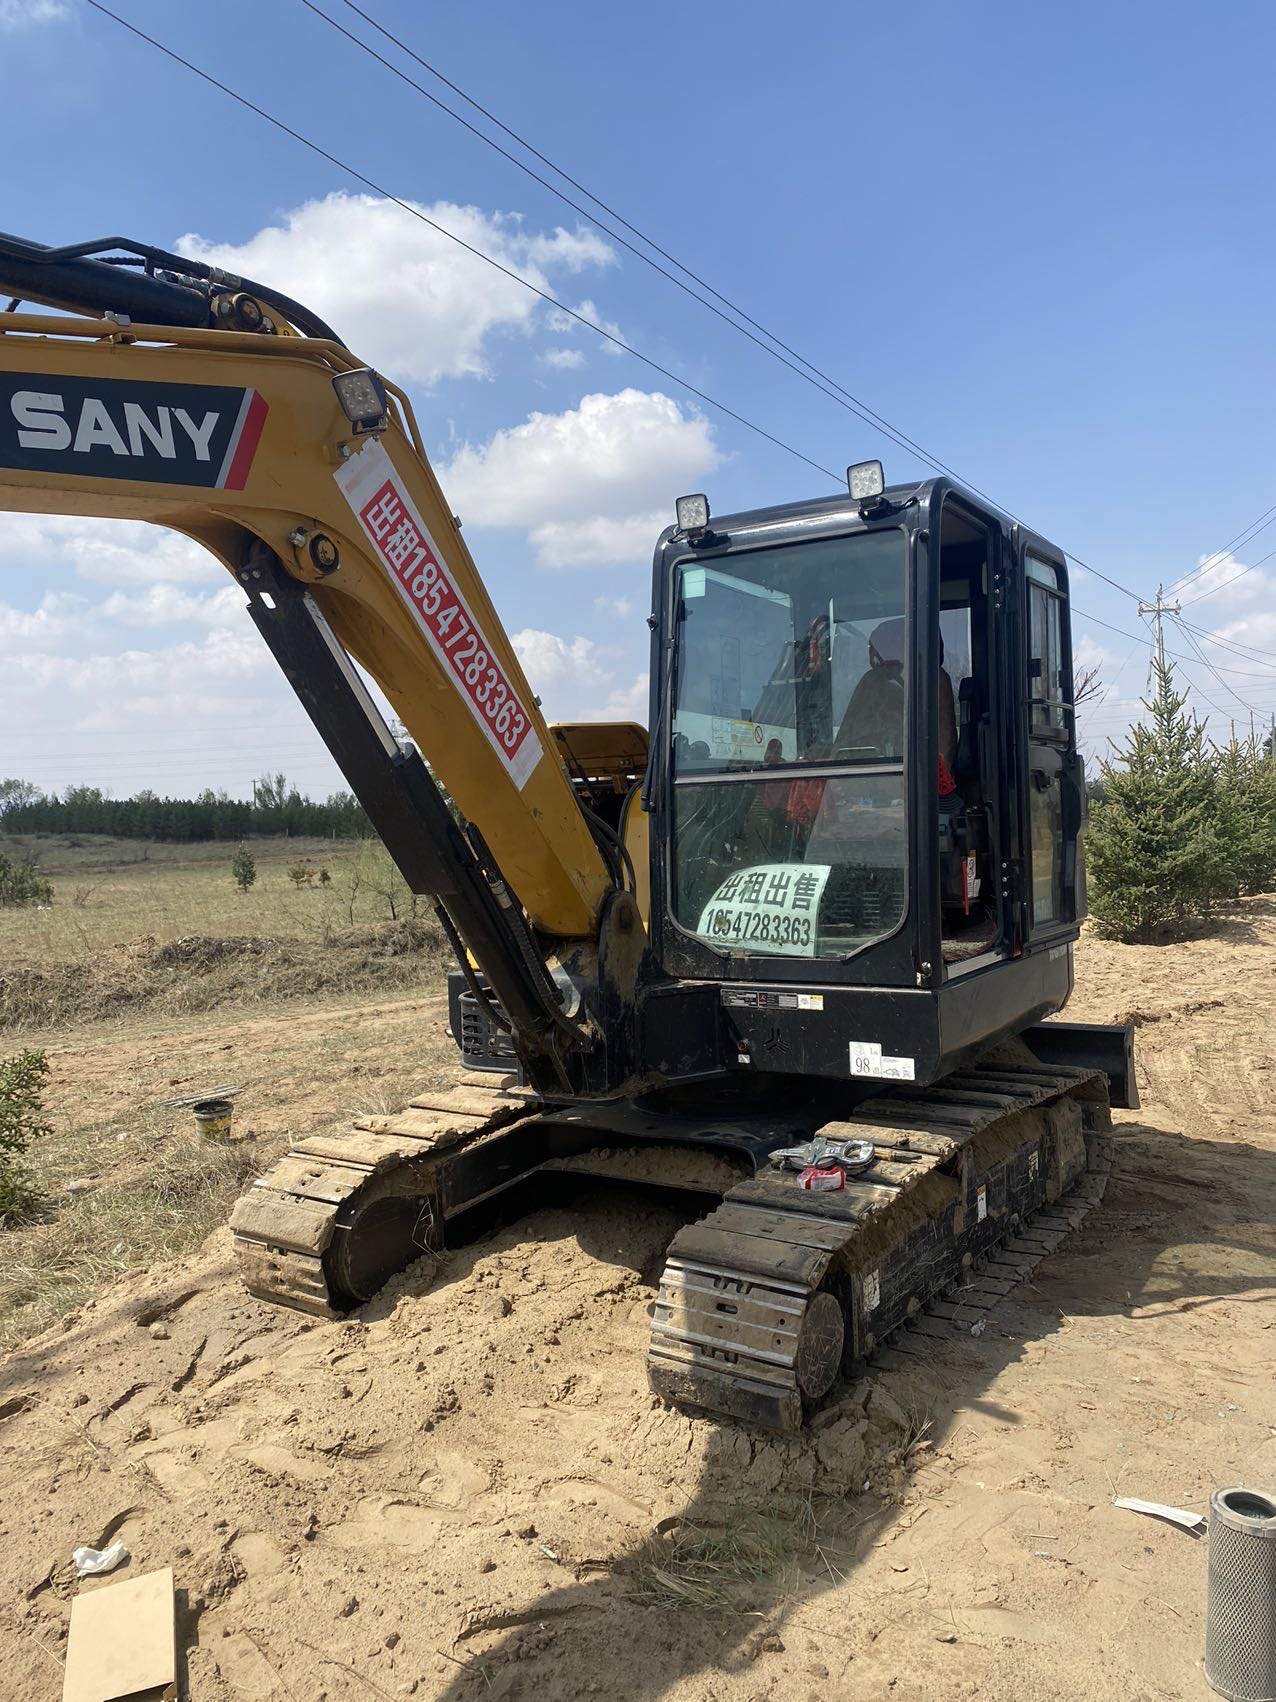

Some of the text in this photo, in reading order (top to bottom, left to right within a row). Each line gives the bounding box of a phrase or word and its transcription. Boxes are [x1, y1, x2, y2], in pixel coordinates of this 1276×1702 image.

[10, 390, 220, 461] SANY
[366, 491, 525, 748] 出租18547283363
[715, 871, 820, 911] 出租出售
[855, 1057, 870, 1074] 98
